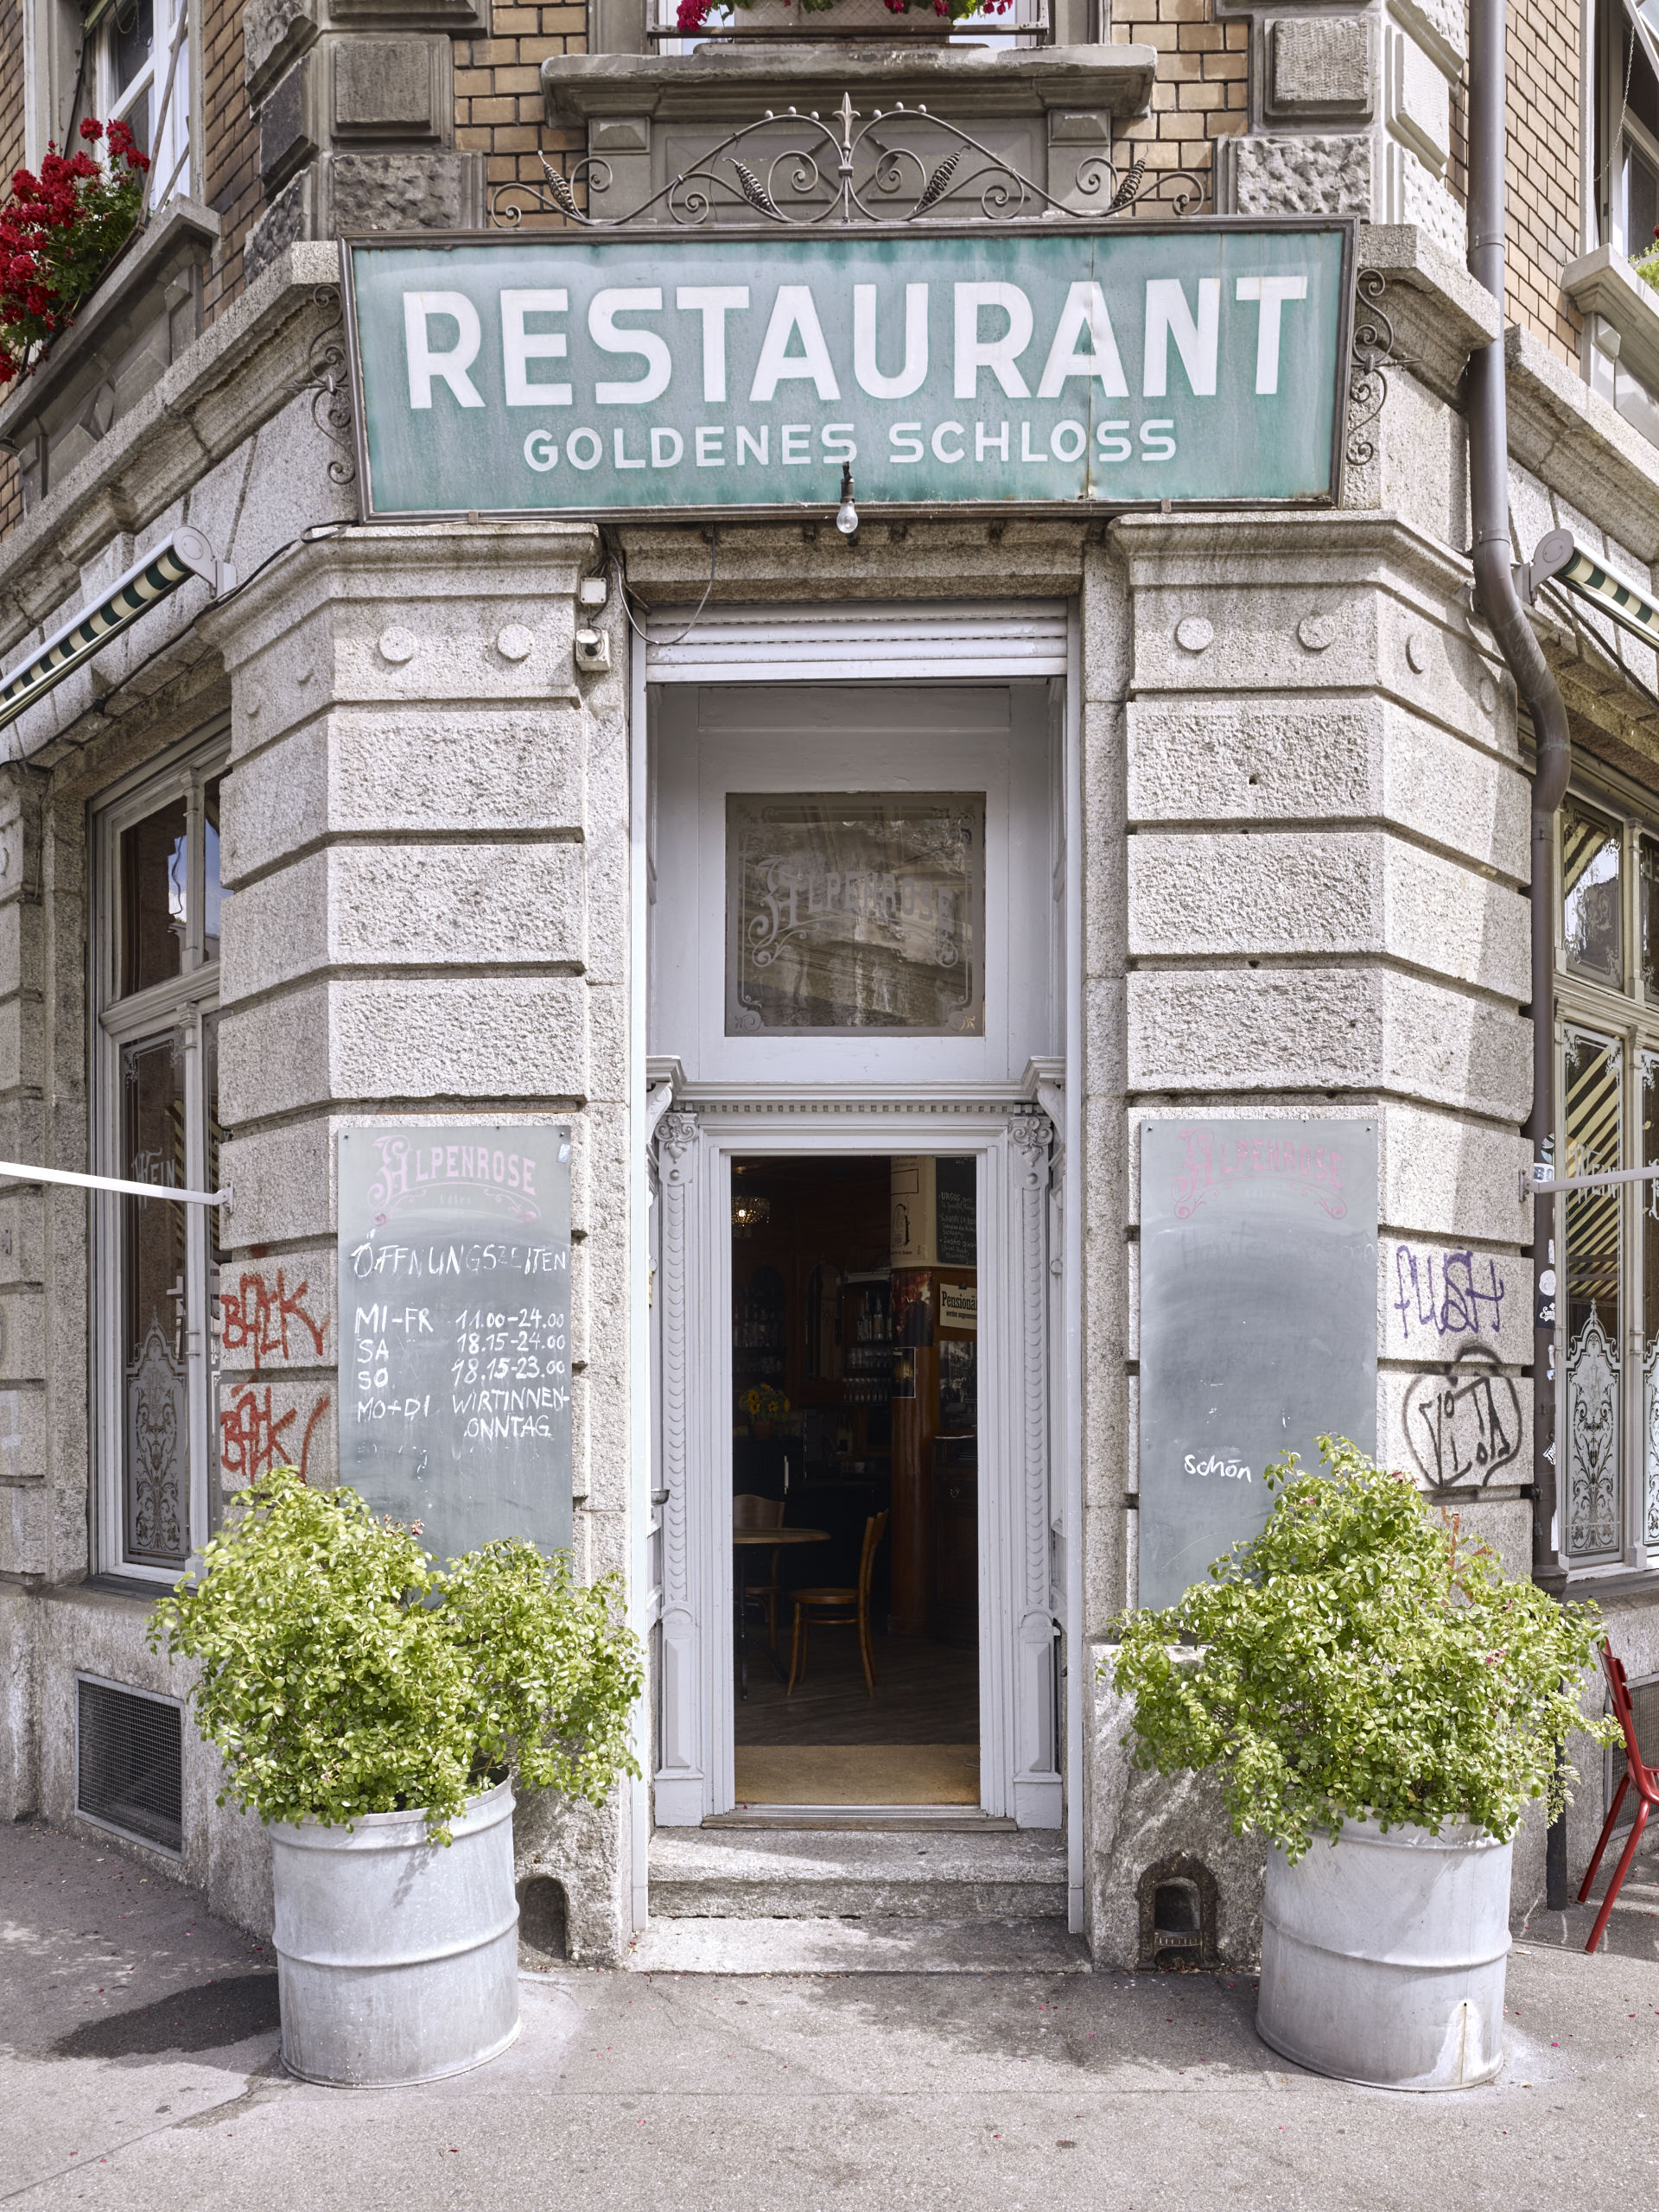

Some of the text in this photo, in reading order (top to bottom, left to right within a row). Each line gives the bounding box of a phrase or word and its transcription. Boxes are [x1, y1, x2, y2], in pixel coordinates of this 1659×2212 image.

[402, 274, 1309, 410] RESTAURANT
[523, 418, 1178, 474] GOLDENES SCHLOSS
[368, 1135, 537, 1201] ALPENROSE
[941, 1290, 977, 1311] Pensionä
[357, 1330, 566, 1363] SA 18.15-24.00
[358, 1355, 566, 1390] SO 18.15-23.00
[463, 1415, 555, 1440] ONNTAG
